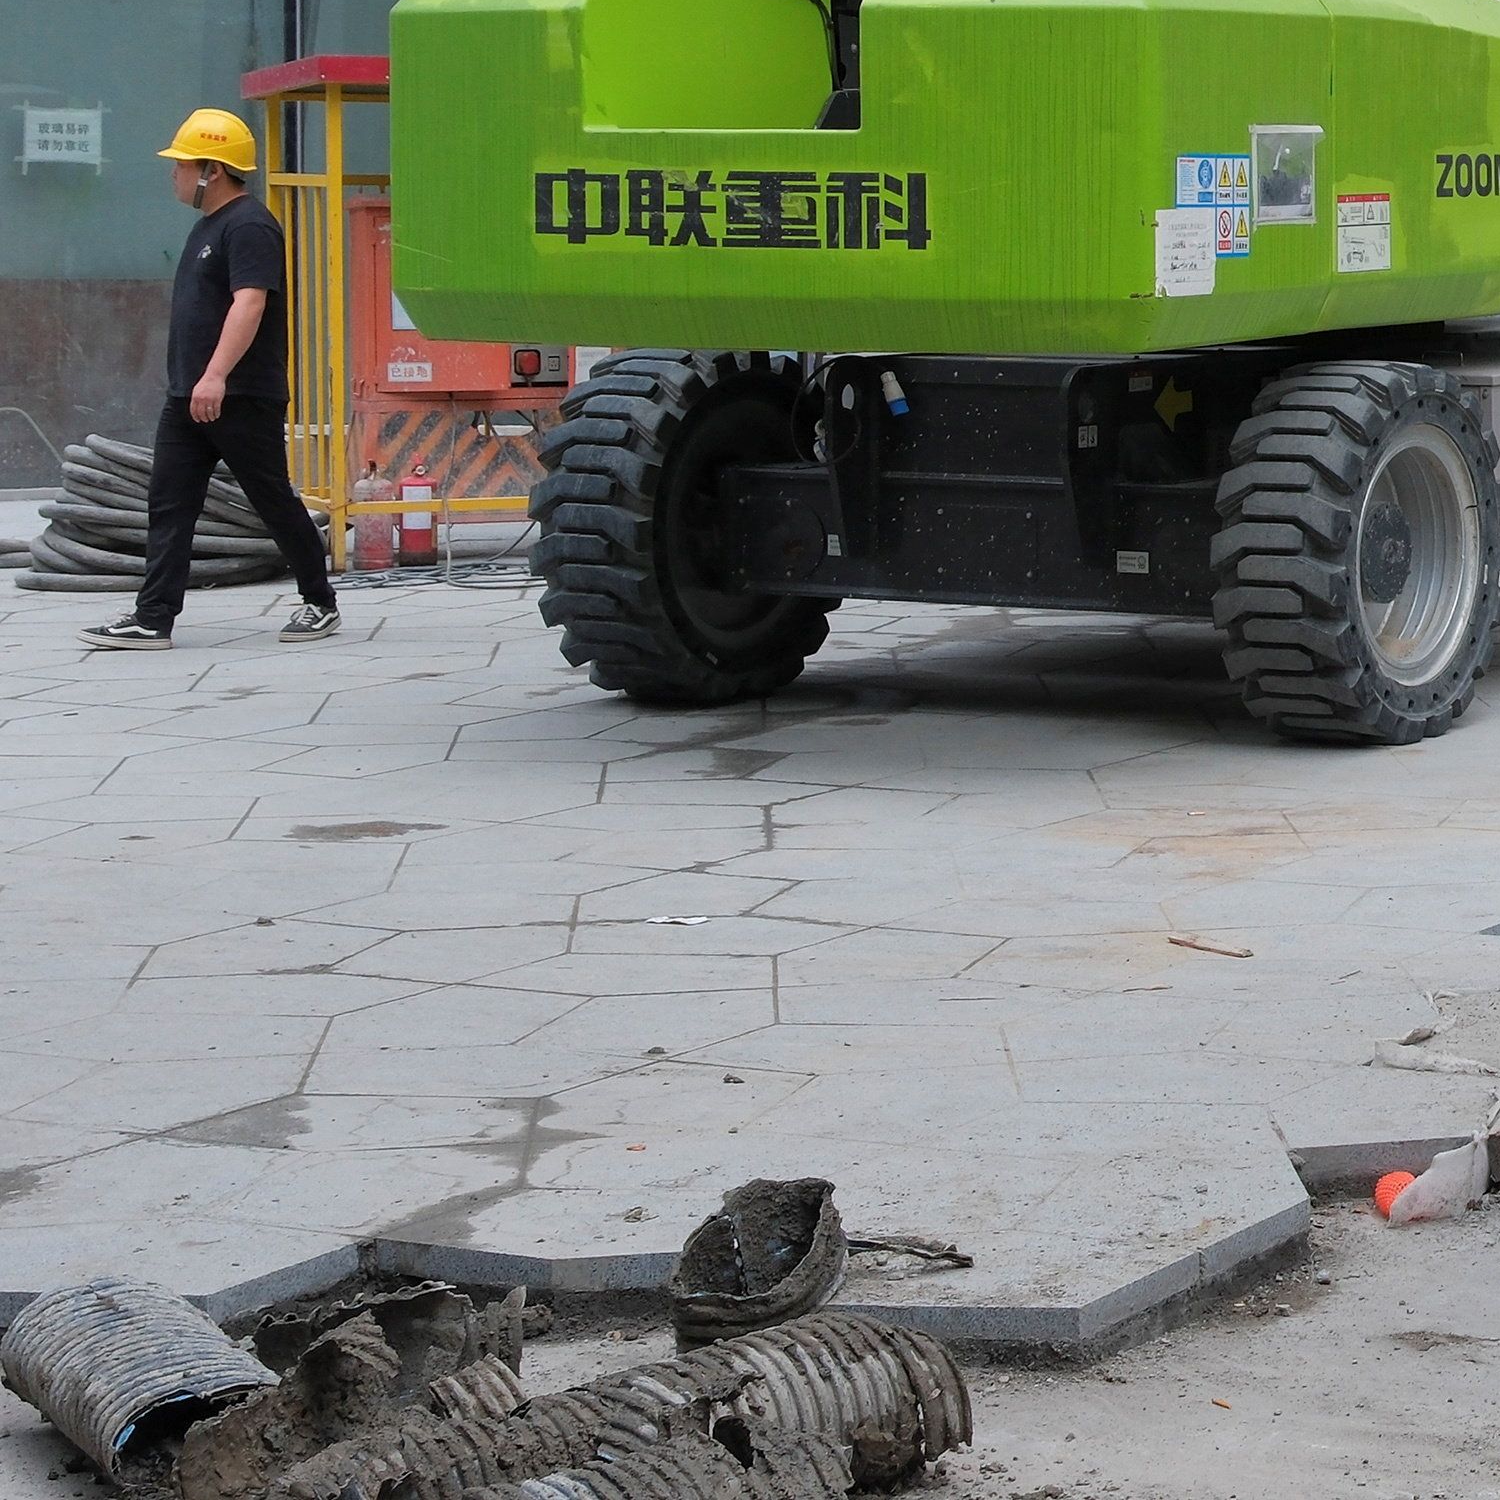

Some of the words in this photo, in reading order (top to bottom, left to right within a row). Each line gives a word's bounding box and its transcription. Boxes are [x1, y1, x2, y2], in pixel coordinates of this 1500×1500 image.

[38, 123, 89, 135] 玻璃易碎
[38, 139, 90, 152] 请勿靠近
[535, 168, 931, 250] 中联重科
